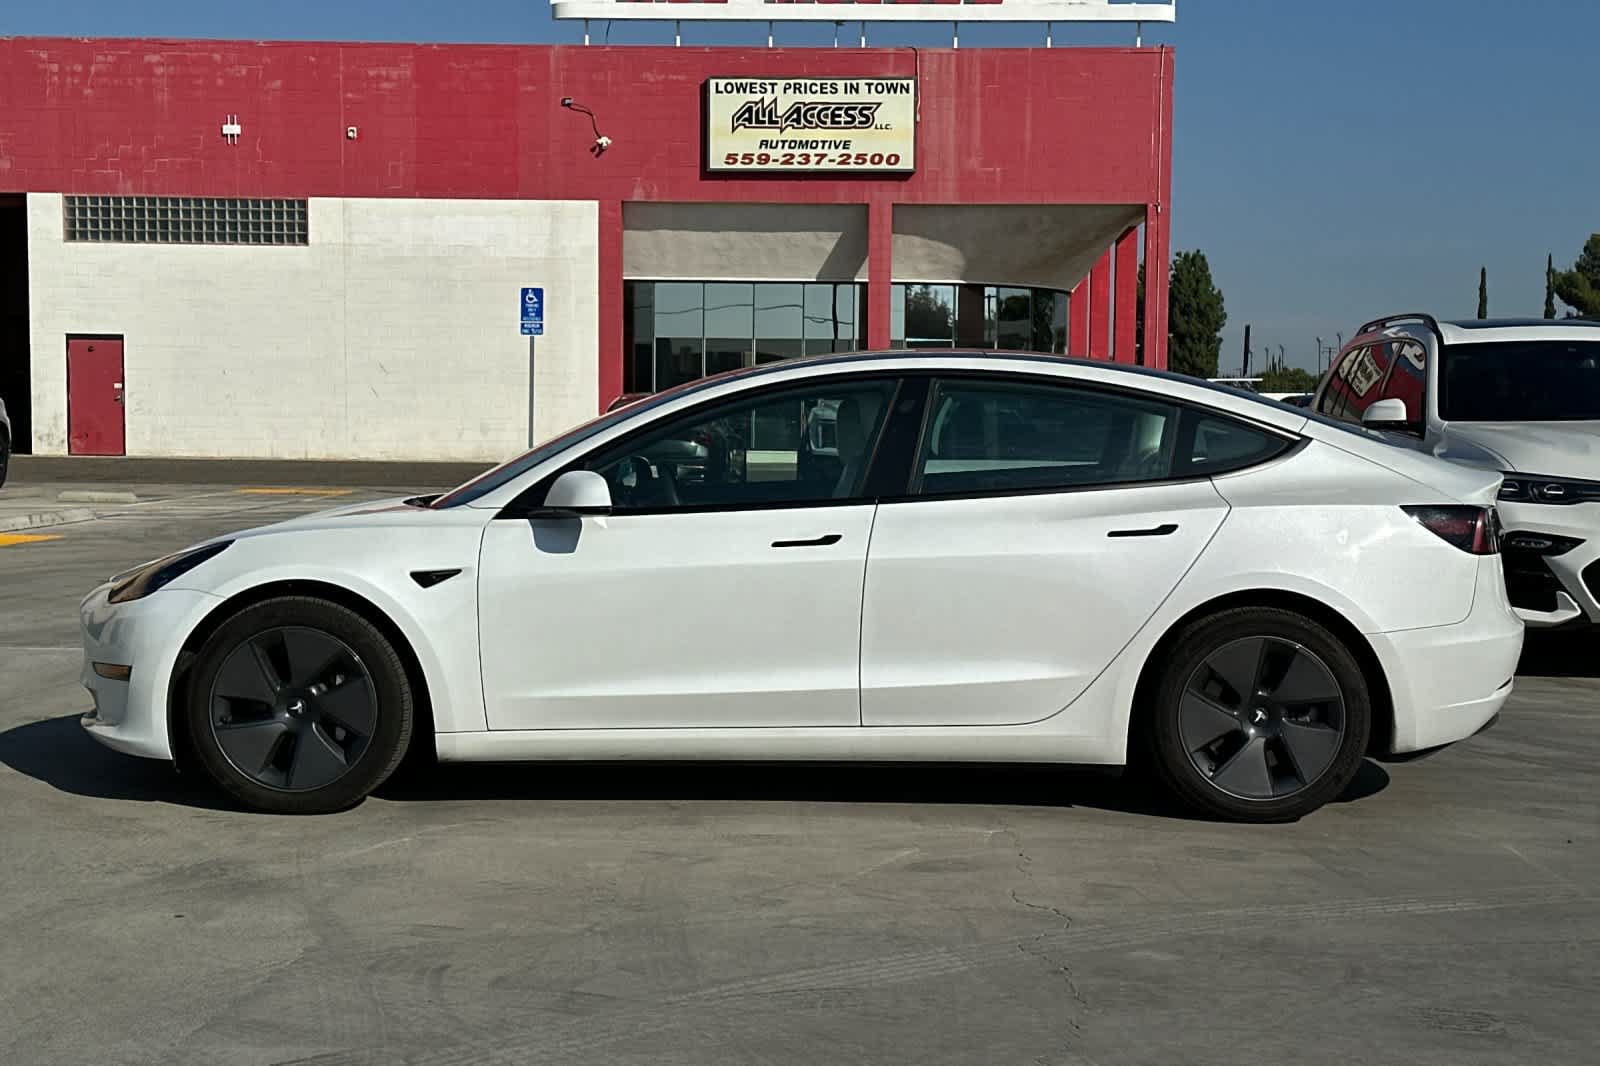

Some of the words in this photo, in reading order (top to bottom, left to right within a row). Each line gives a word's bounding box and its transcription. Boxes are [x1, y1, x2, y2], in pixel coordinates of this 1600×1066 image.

[715, 82, 777, 95] LOWEST
[783, 82, 838, 95] PRICES
[844, 82, 860, 95] IN
[866, 82, 911, 95] TOWN
[732, 97, 782, 134] ALL
[780, 101, 882, 134] ACCESS
[759, 139, 852, 150] AUTOMOTIVE
[724, 153, 901, 166] 559-237-2500
